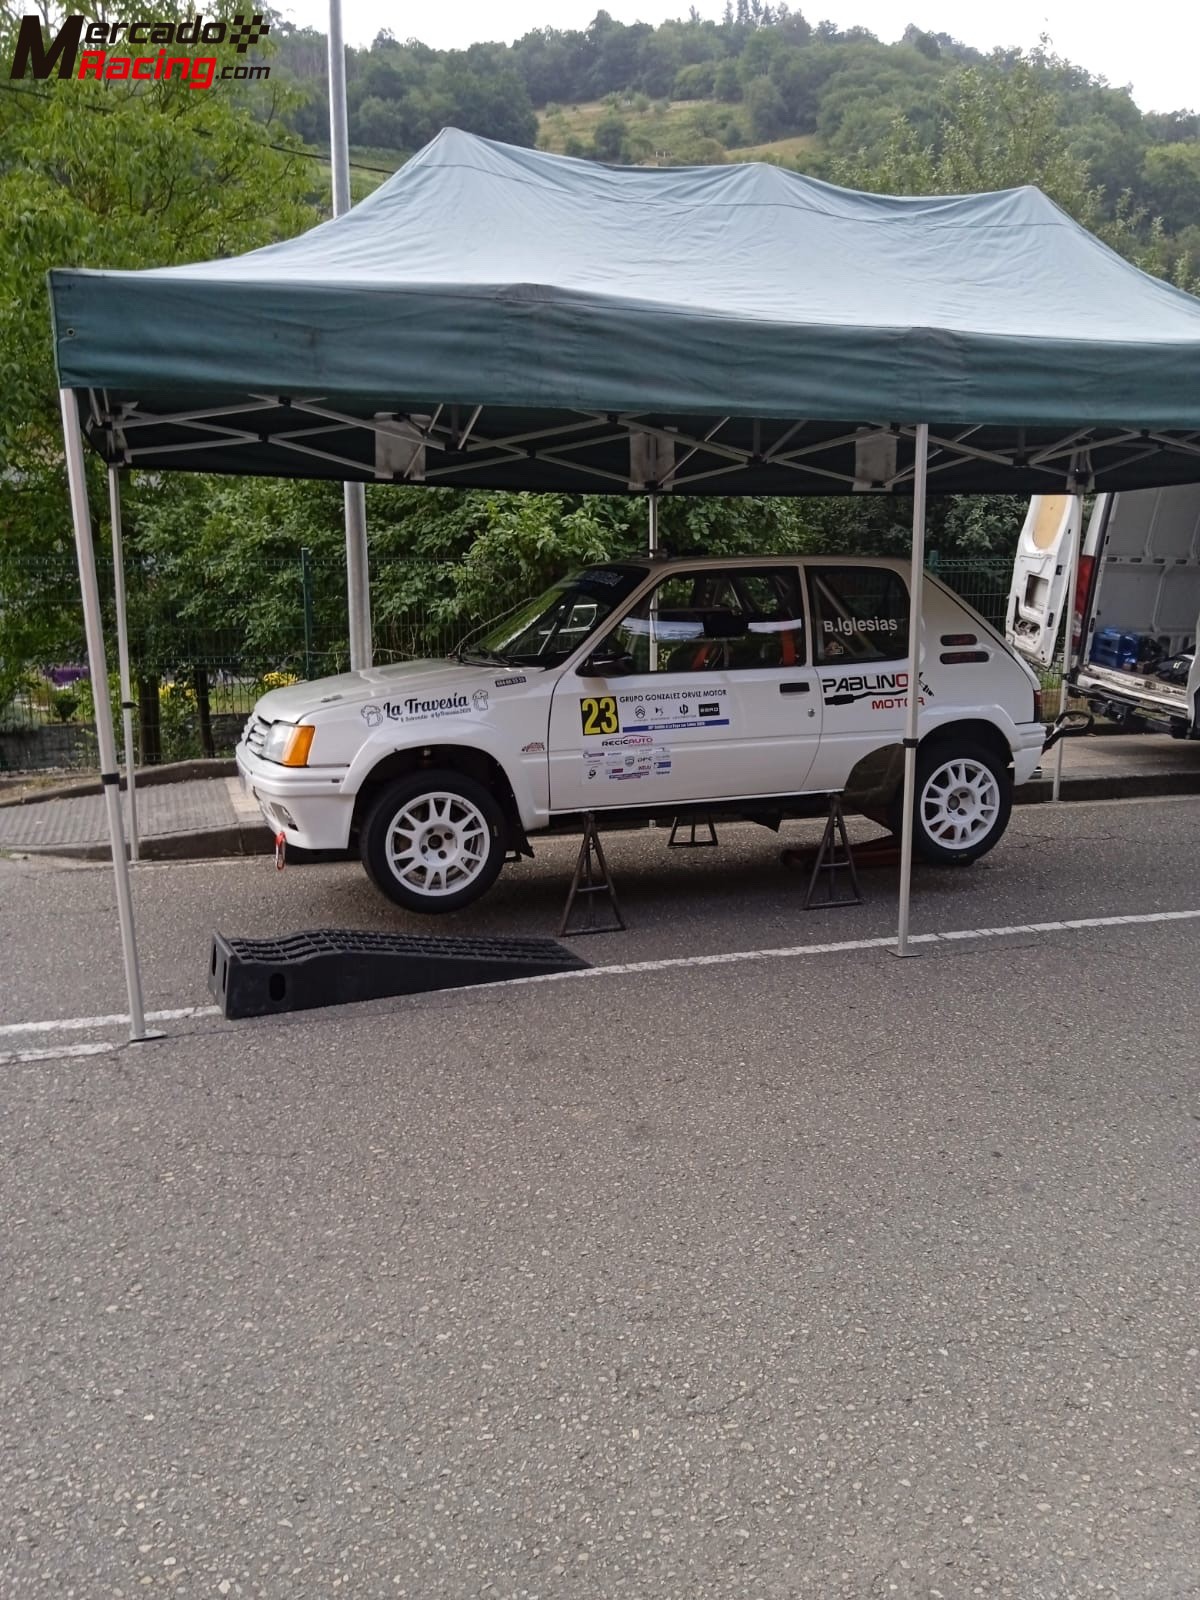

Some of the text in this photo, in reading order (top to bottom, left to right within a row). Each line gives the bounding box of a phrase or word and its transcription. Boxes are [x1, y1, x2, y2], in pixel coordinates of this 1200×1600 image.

[823, 616, 898, 636] B.Iglesias
[619, 695, 644, 703] GRUPO
[645, 692, 680, 702] GONZALEZ
[703, 689, 727, 697] MOTOR
[383, 702, 402, 721] La
[404, 692, 469, 714] Travesía
[582, 697, 618, 735] 23
[601, 738, 653, 747] RECICAUTO
